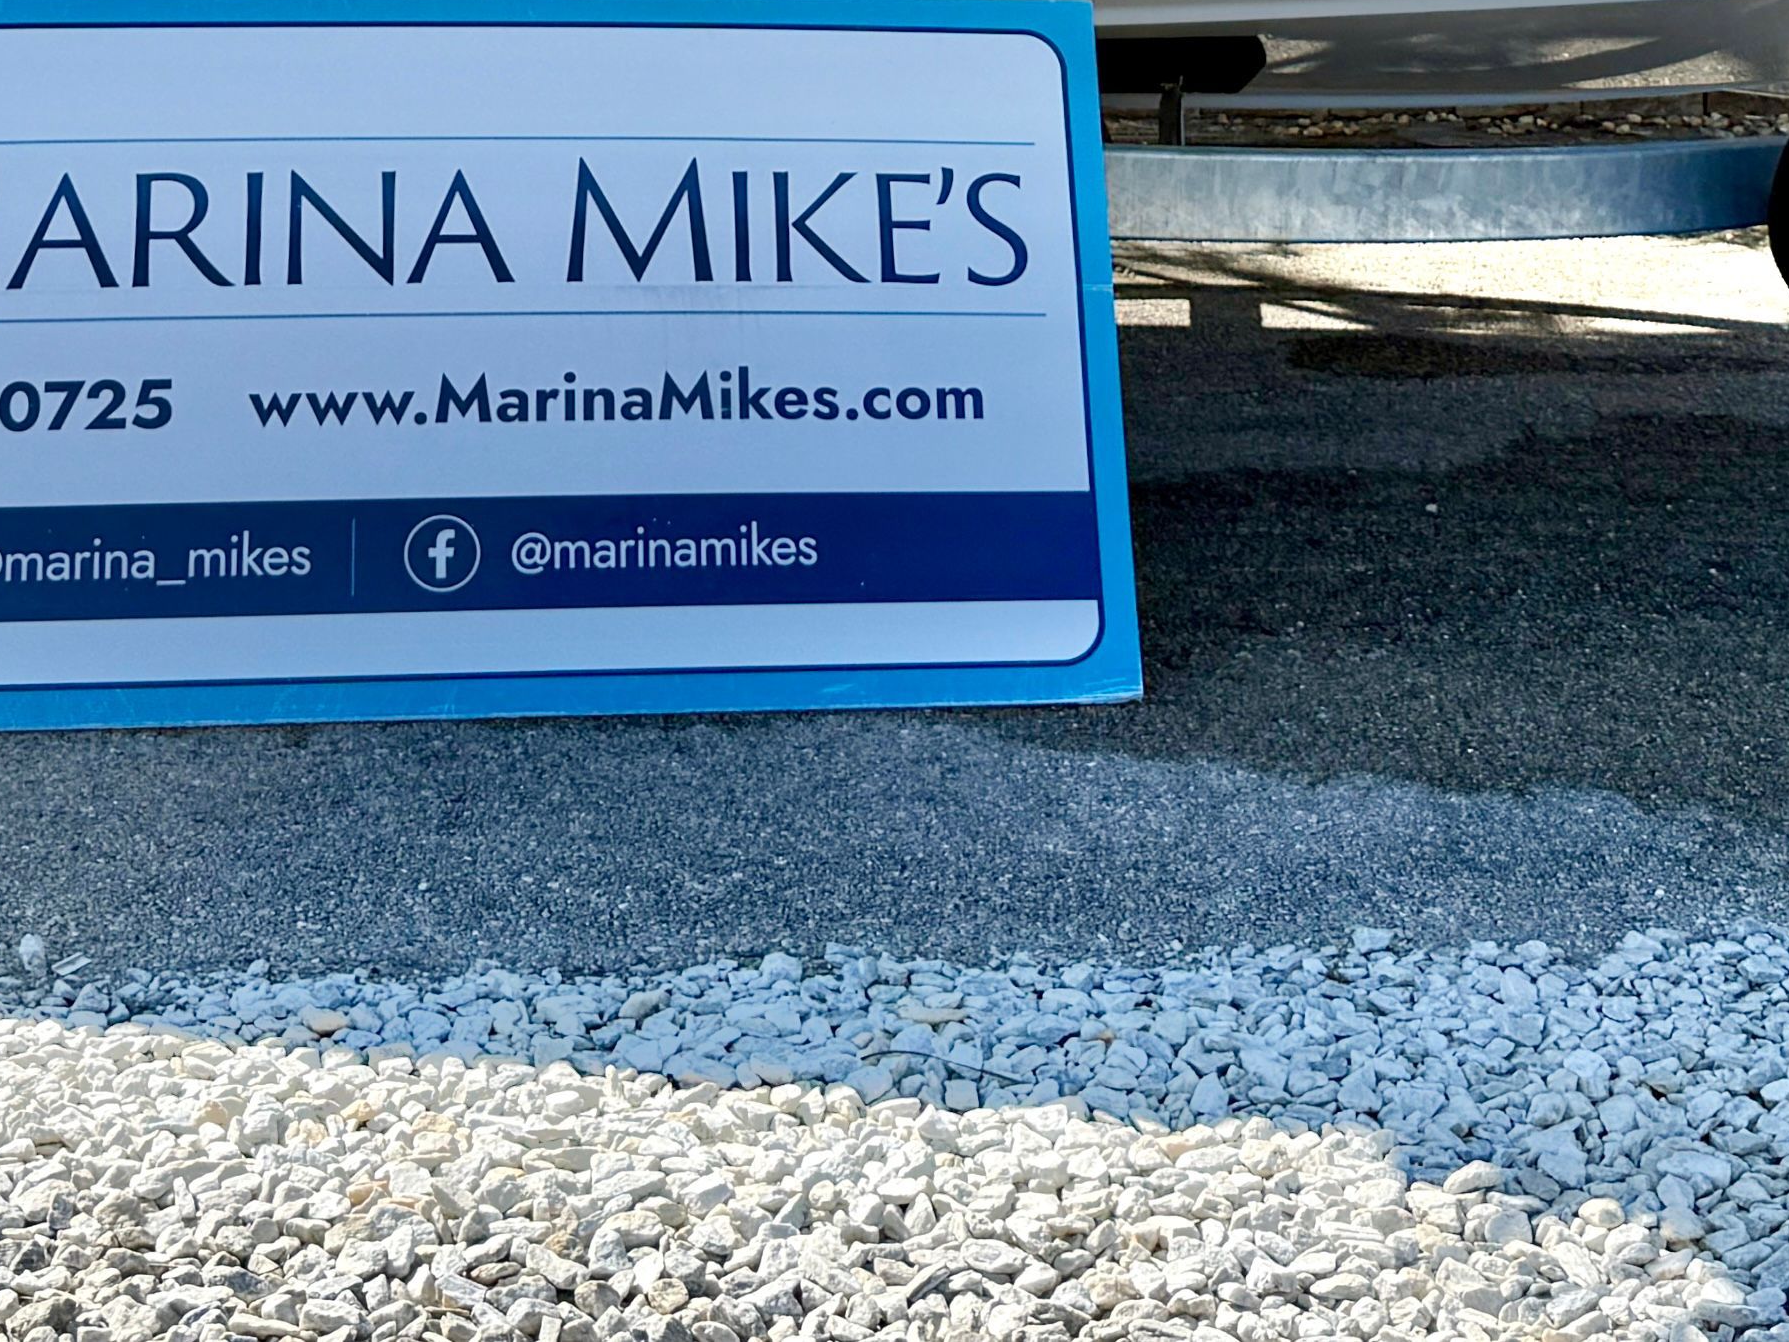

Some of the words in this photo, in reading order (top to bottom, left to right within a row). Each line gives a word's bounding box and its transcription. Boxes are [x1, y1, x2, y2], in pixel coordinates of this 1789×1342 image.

[566, 156, 1029, 286] MIKE'S
[249, 366, 985, 428] www.MarinaMikes.com
[512, 521, 818, 575] @marinamikes
